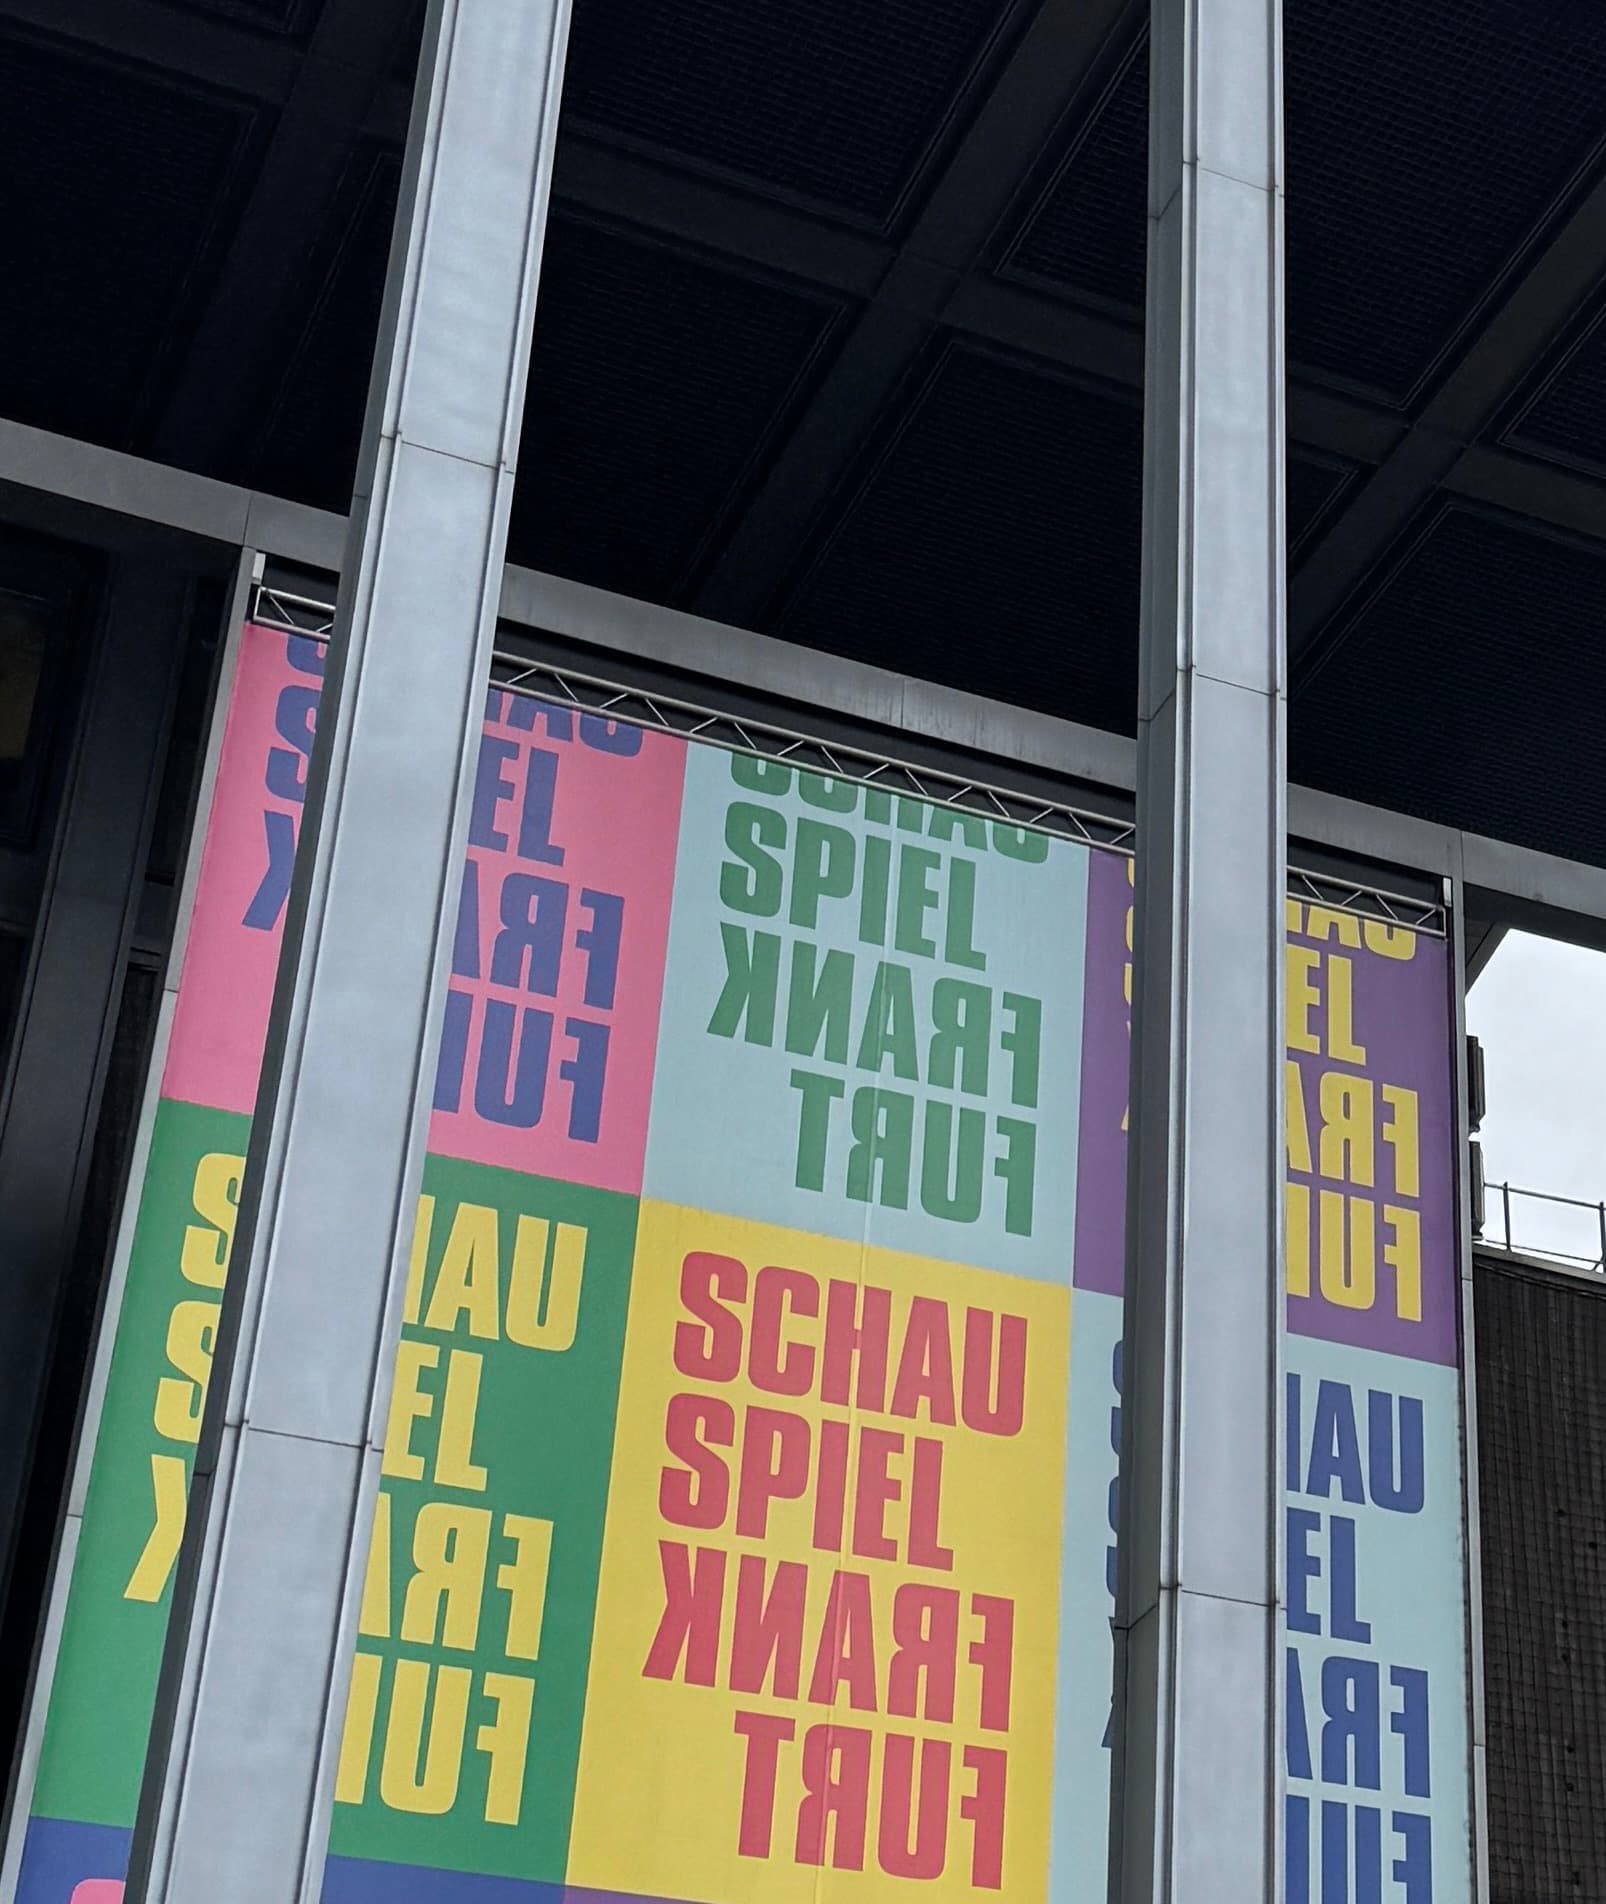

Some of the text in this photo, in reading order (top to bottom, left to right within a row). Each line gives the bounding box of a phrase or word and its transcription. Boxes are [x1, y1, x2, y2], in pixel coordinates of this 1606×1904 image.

[719, 801, 987, 972] SPIEL
[673, 1250, 1029, 1438] SCHAU
[659, 1392, 956, 1572] SPIEL
